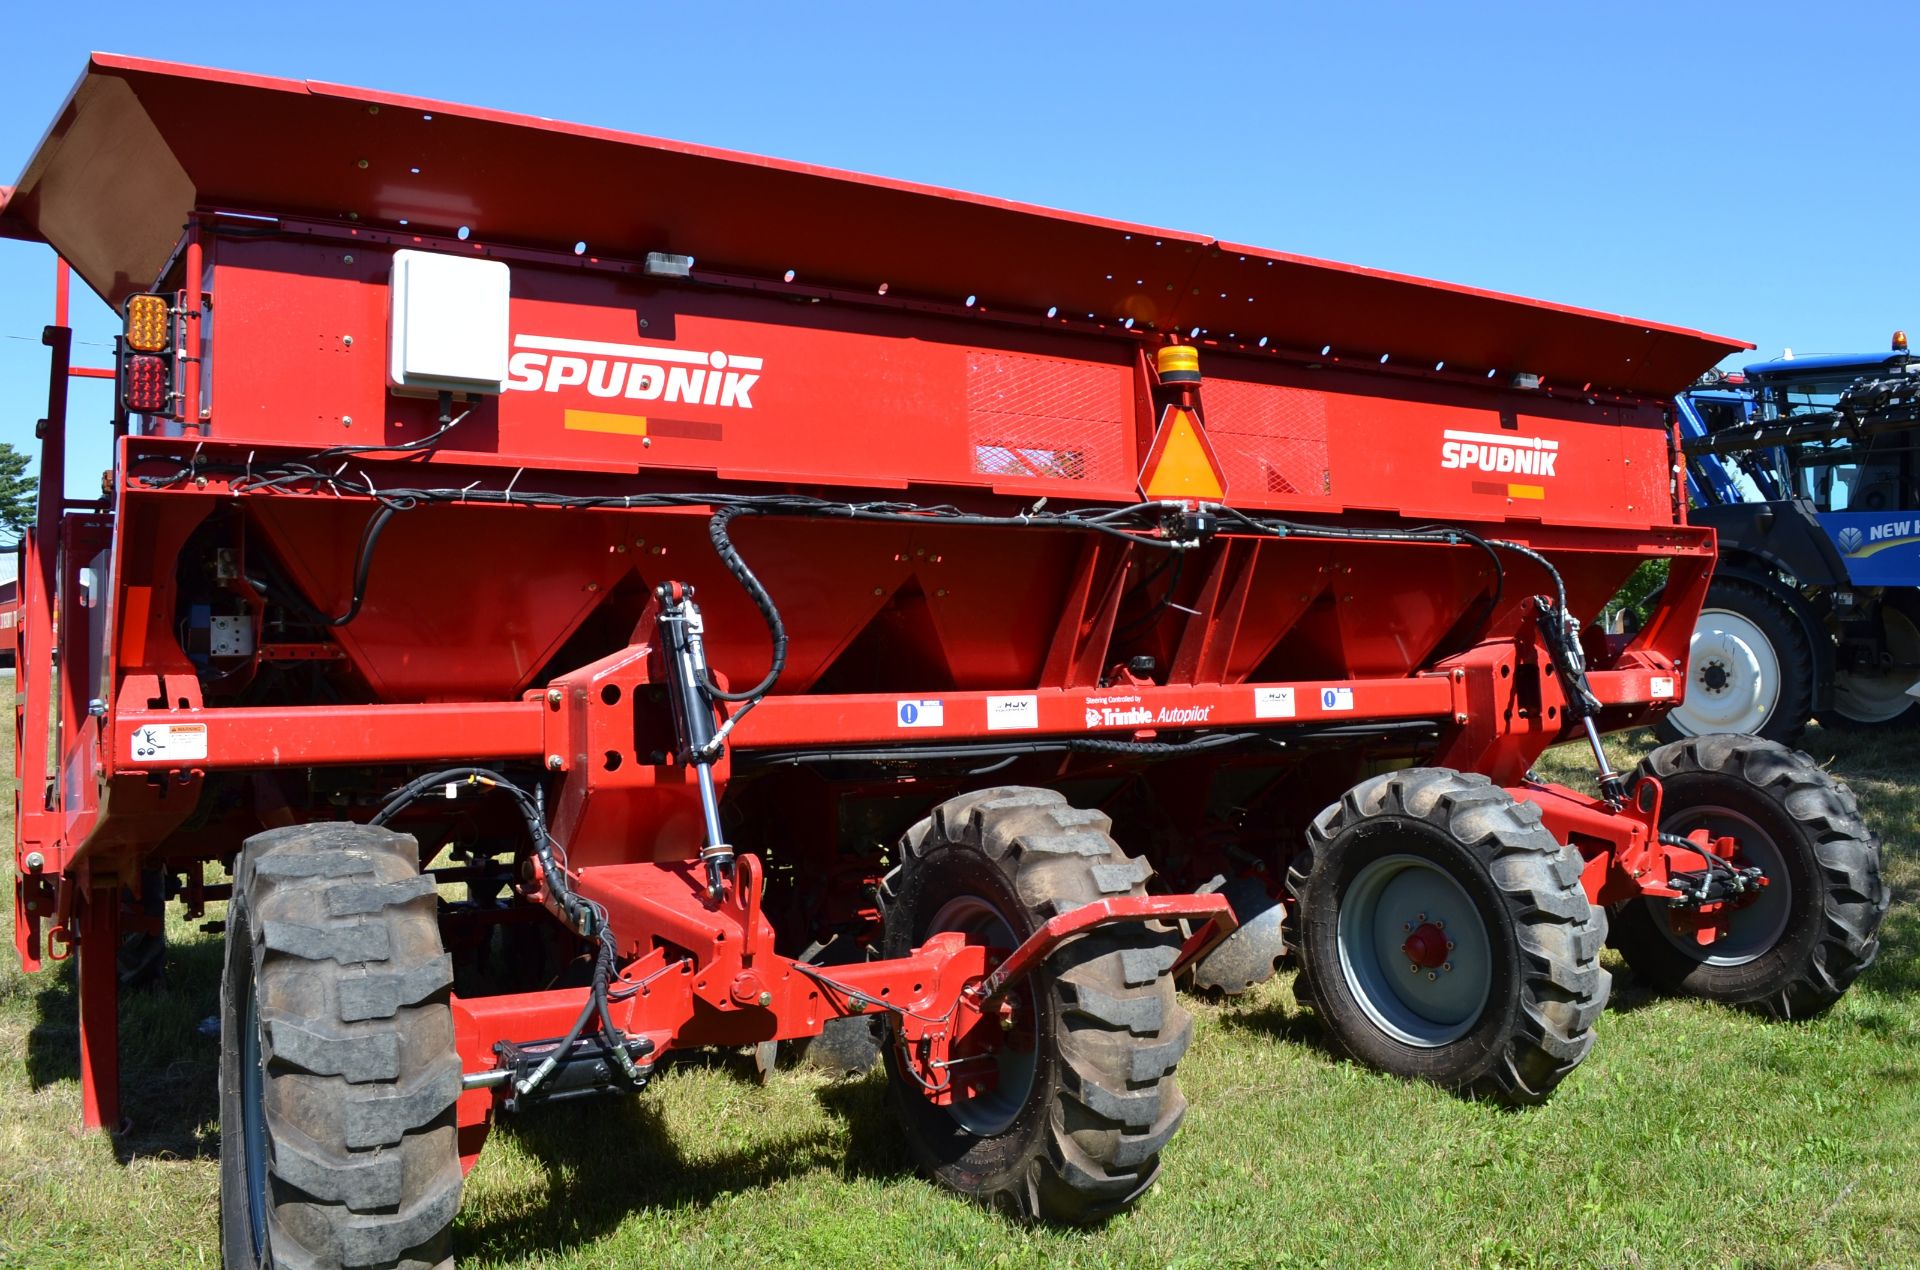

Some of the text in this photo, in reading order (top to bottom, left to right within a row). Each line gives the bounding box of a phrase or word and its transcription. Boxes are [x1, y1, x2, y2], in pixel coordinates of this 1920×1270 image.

[1870, 520, 1911, 541] NEW
[1085, 695, 1142, 705] Steering Controlled by
[1101, 704, 1210, 726] Trimble Autopilot
